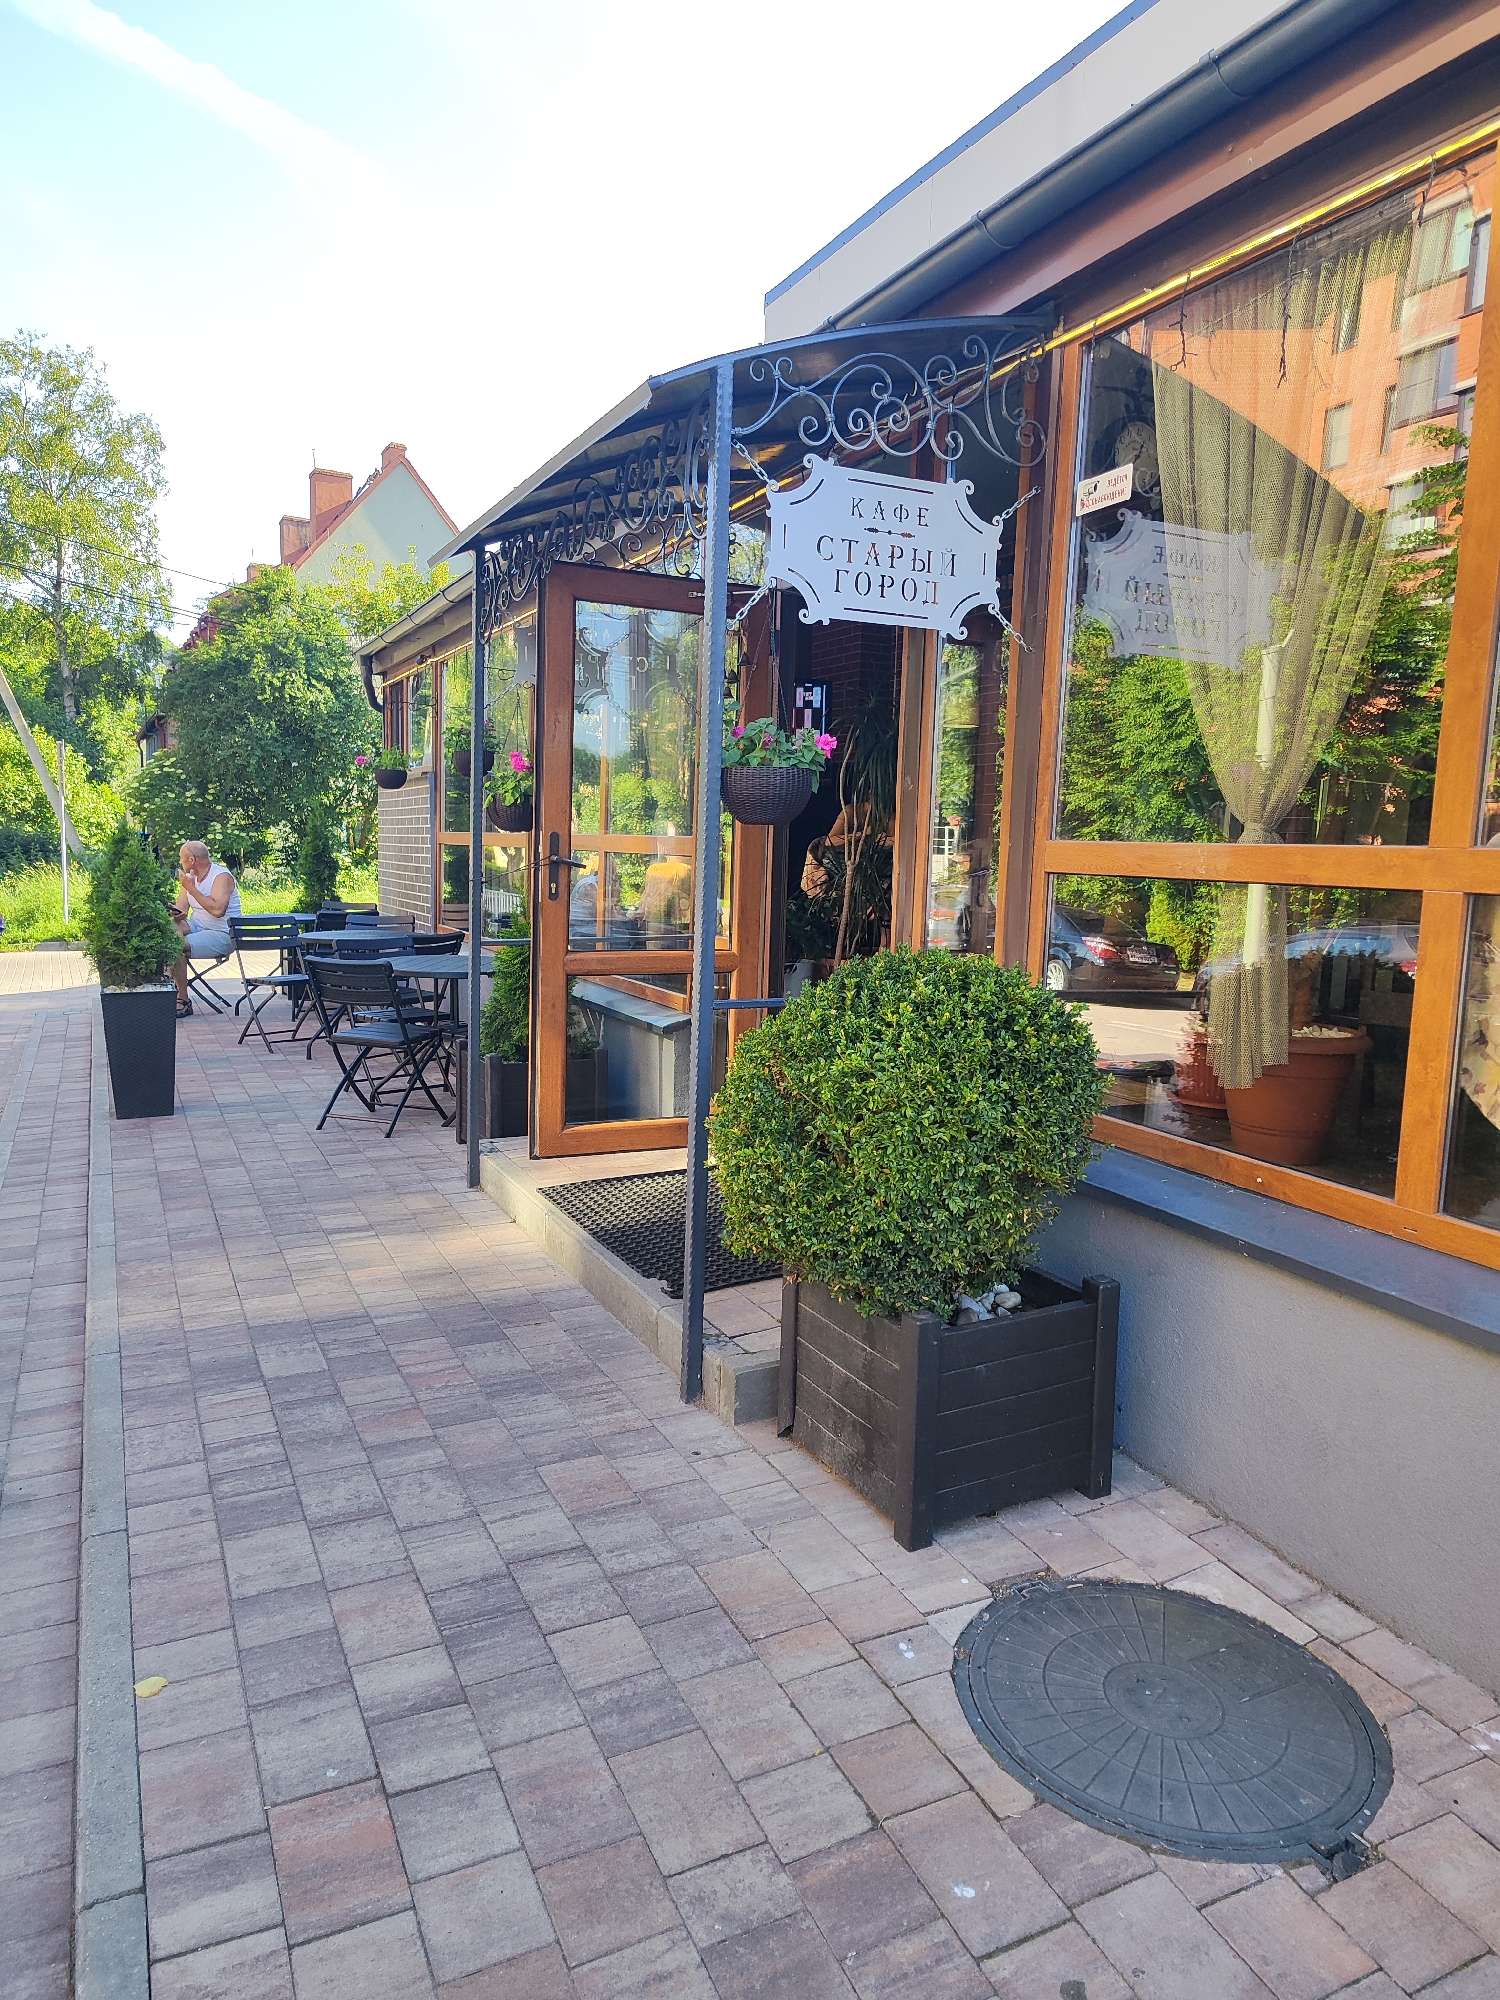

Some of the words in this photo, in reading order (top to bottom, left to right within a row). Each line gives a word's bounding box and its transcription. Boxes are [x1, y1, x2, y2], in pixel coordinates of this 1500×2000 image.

[850, 496, 930, 527] КАФЕ
[816, 535, 957, 577] СТАРЫЙ
[833, 568, 940, 606] ГОРОД
